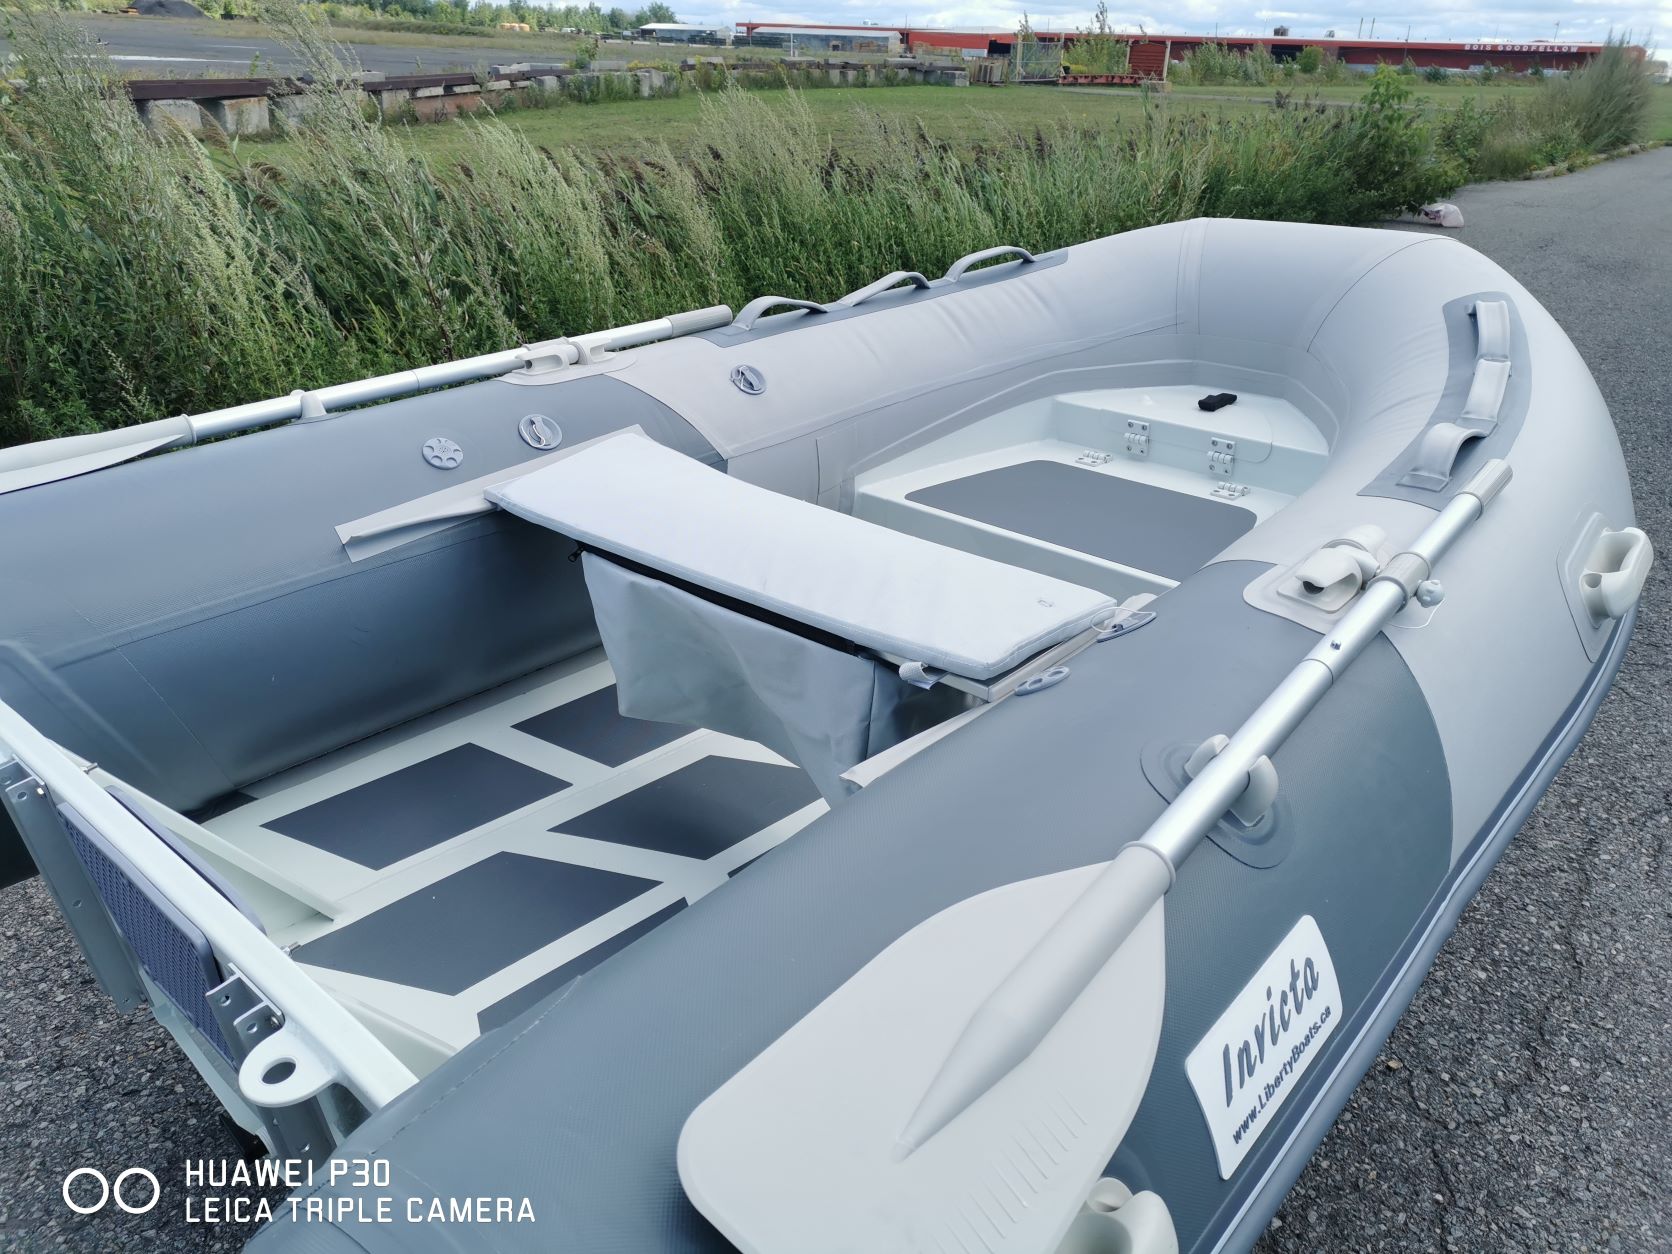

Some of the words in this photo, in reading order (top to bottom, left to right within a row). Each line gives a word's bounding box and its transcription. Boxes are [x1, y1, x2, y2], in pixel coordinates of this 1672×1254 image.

[1464, 43, 1492, 51] BOIS
[1497, 44, 1579, 53] GOODFELLOW
[1222, 956, 1320, 1108] Invicta
[1232, 1005, 1332, 1145] www.LibertyBoats.ca
